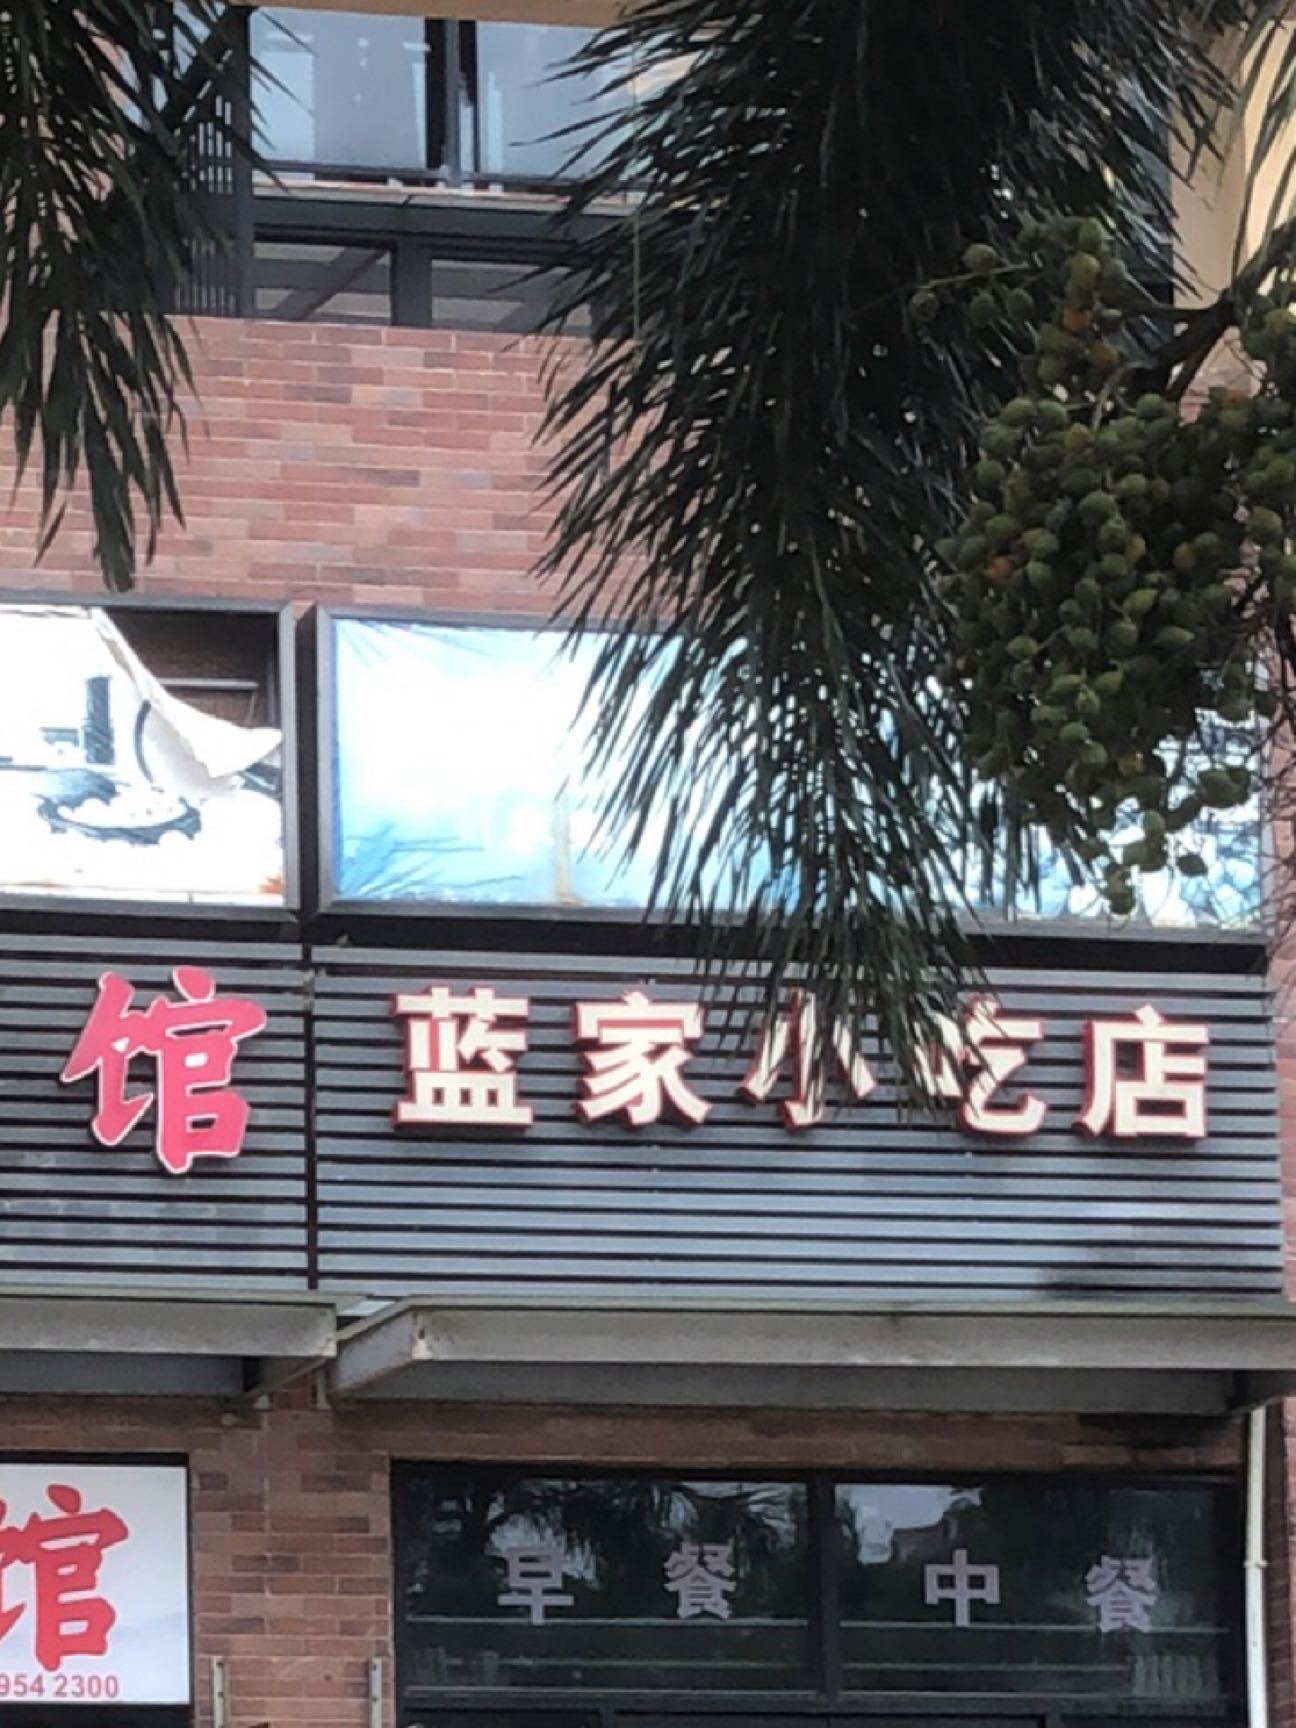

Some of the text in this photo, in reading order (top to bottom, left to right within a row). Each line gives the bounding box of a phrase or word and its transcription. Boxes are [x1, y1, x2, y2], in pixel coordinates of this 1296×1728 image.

[392, 984, 1211, 1142] 蓝家小吃店
[499, 1541, 1159, 1634] 早餐 中餐
[54, 1675, 120, 1698] 2300
